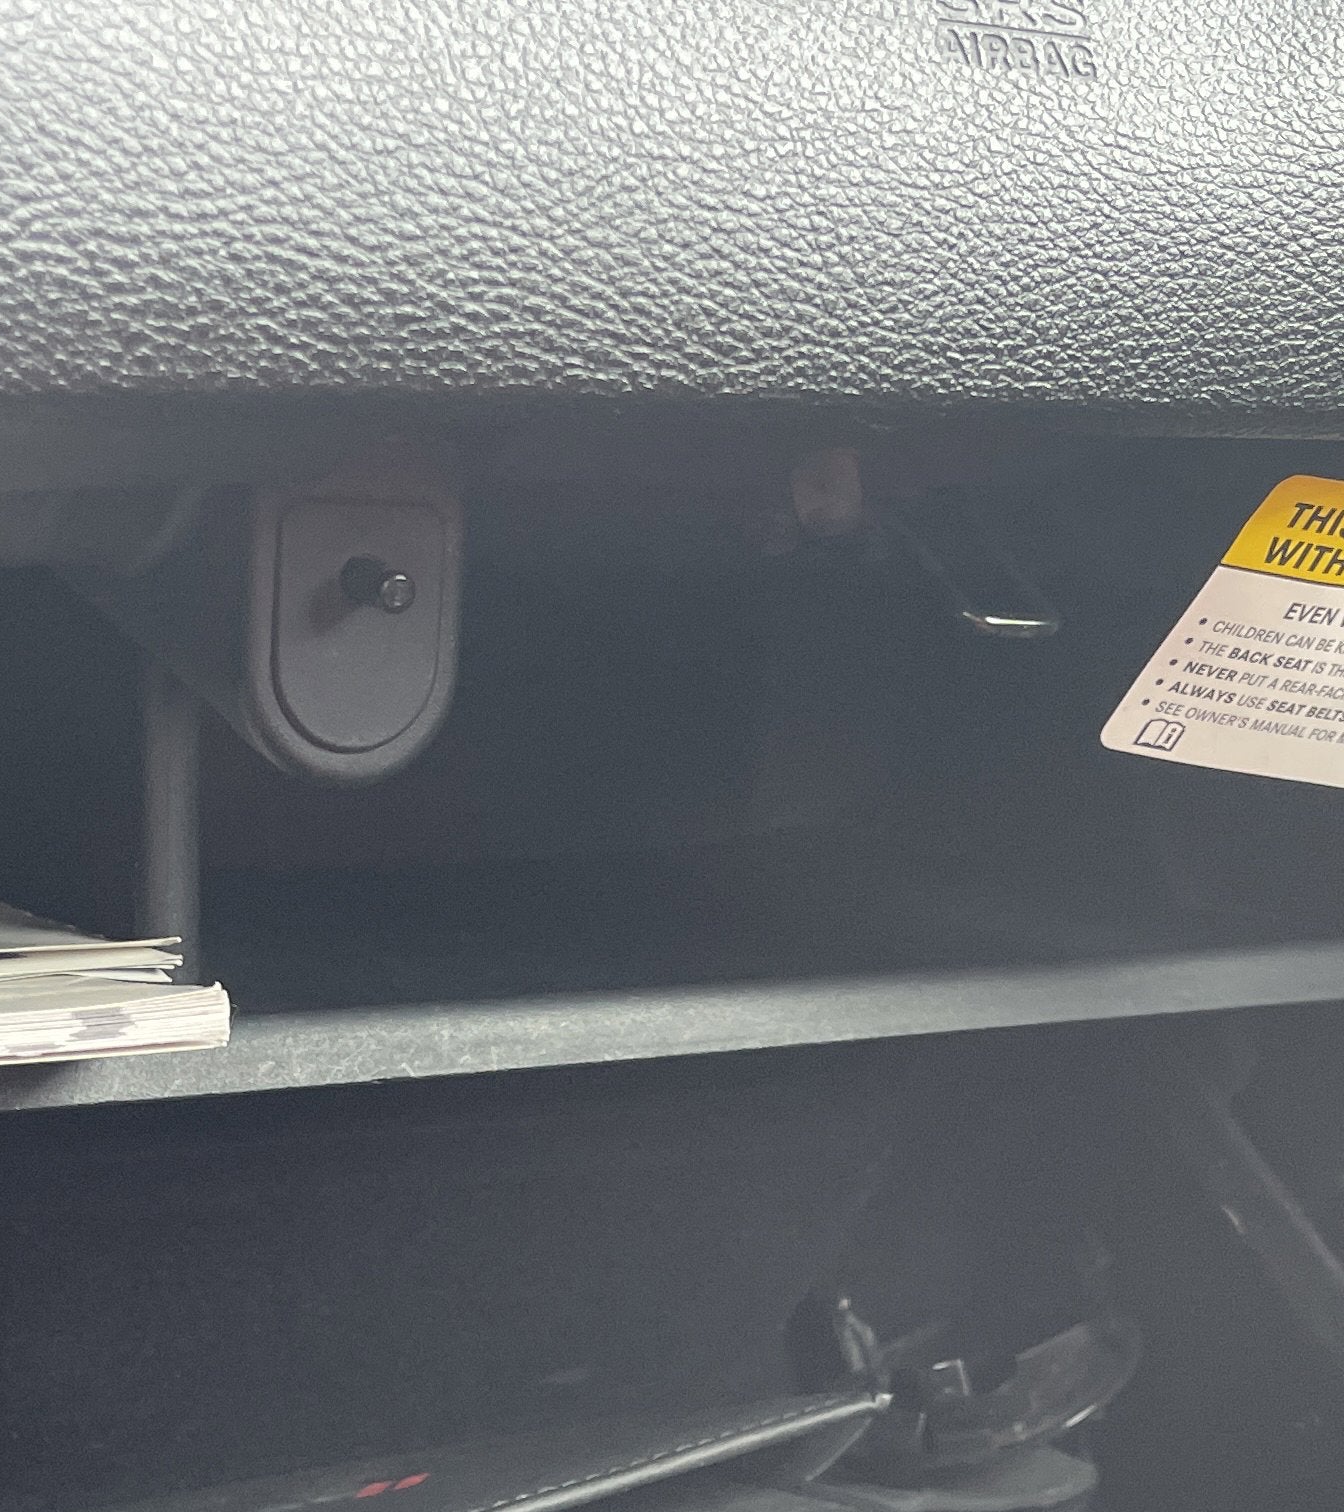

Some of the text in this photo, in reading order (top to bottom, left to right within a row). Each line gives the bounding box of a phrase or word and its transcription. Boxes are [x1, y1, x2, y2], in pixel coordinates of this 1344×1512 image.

[936, 29, 1097, 78] AIRBAG
[1283, 602, 1338, 626] EVEN
[1212, 620, 1285, 645] CHILDREN
[1285, 634, 1316, 650] CAN
[1315, 638, 1336, 652] BE
[1198, 640, 1228, 657] THE
[1227, 647, 1274, 666] BACK
[1273, 656, 1313, 672] SEAT
[1311, 662, 1326, 675] IS
[1183, 661, 1238, 682] NEVER
[1238, 672, 1268, 688] PUT
[1267, 678, 1279, 690] A
[1168, 681, 1237, 704] ALWAYS
[1236, 694, 1267, 710] USE
[1266, 700, 1307, 715] SEAT
[1155, 701, 1185, 716] SEE
[1184, 707, 1250, 729] OWNER'S
[1249, 719, 1306, 738] MANUAL
[1307, 728, 1337, 743] FOR
